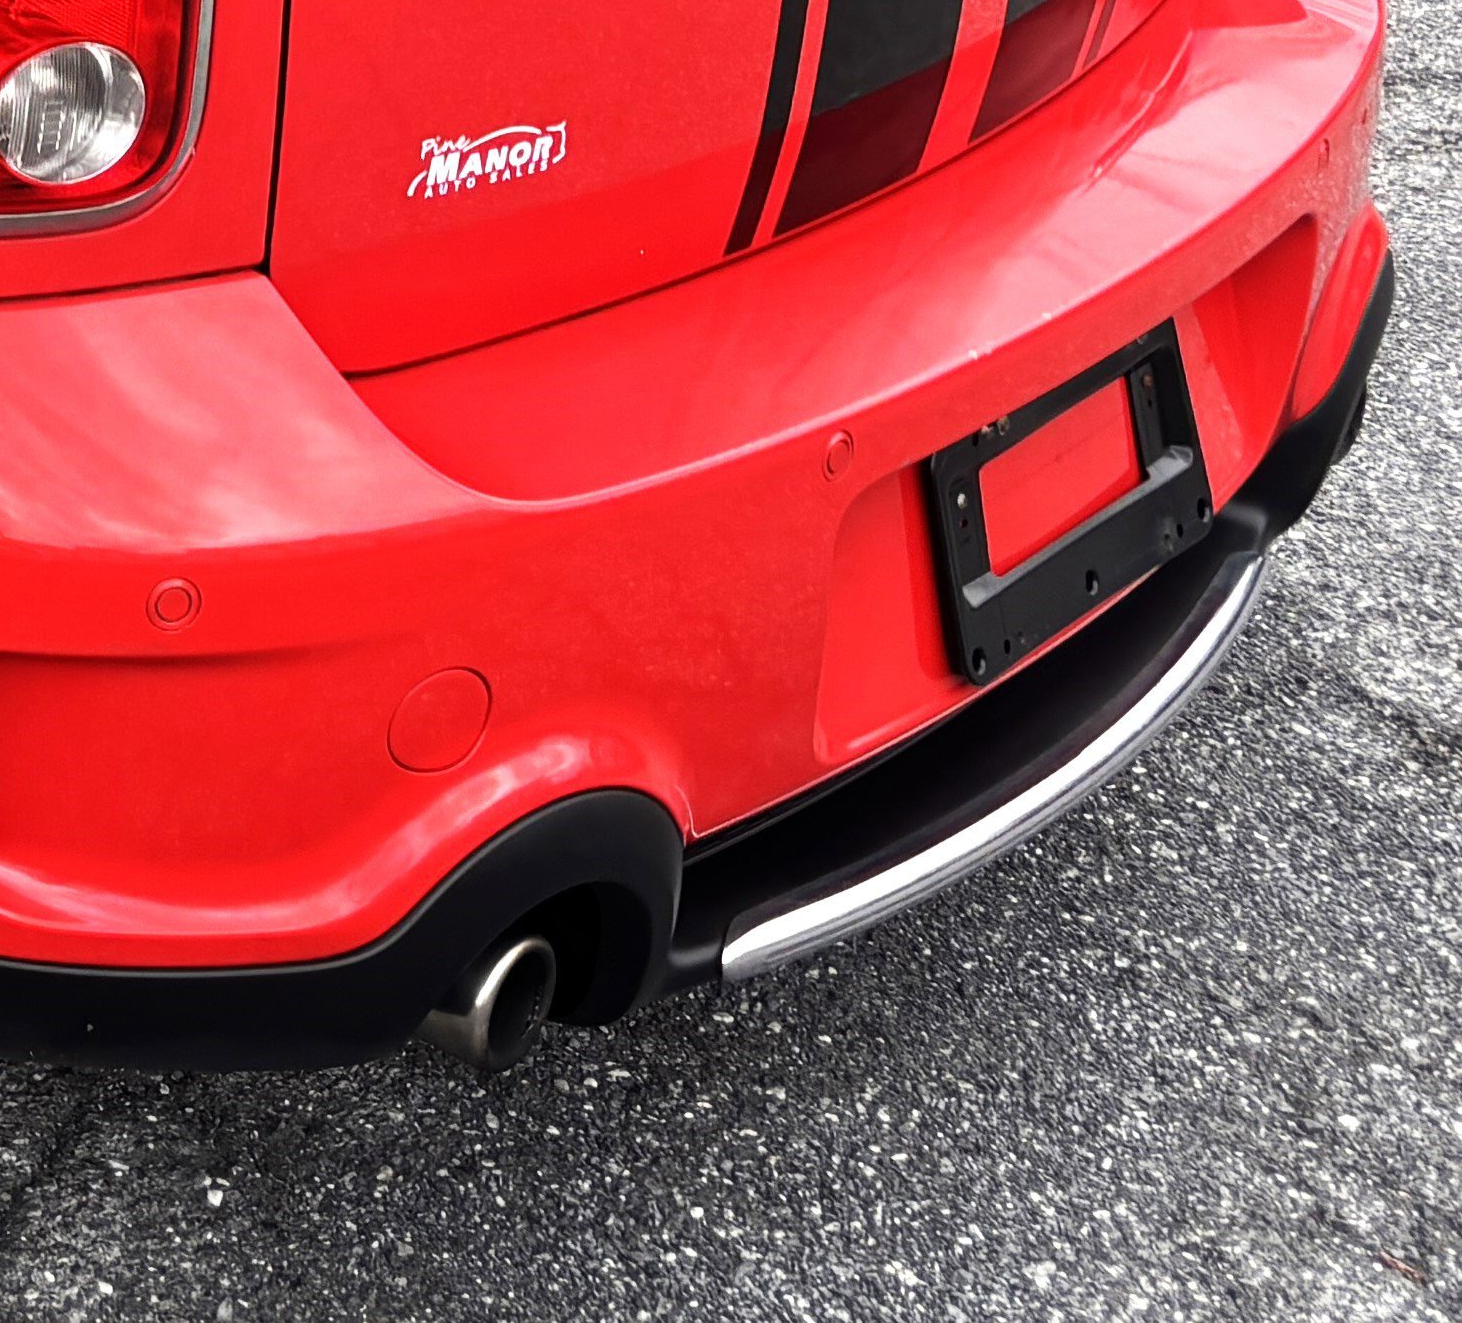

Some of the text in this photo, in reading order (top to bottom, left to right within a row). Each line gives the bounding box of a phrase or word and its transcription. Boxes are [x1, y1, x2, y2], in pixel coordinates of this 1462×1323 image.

[420, 134, 472, 161] Pine
[425, 135, 555, 188] MANOR
[424, 159, 550, 199] AUTO SALES
